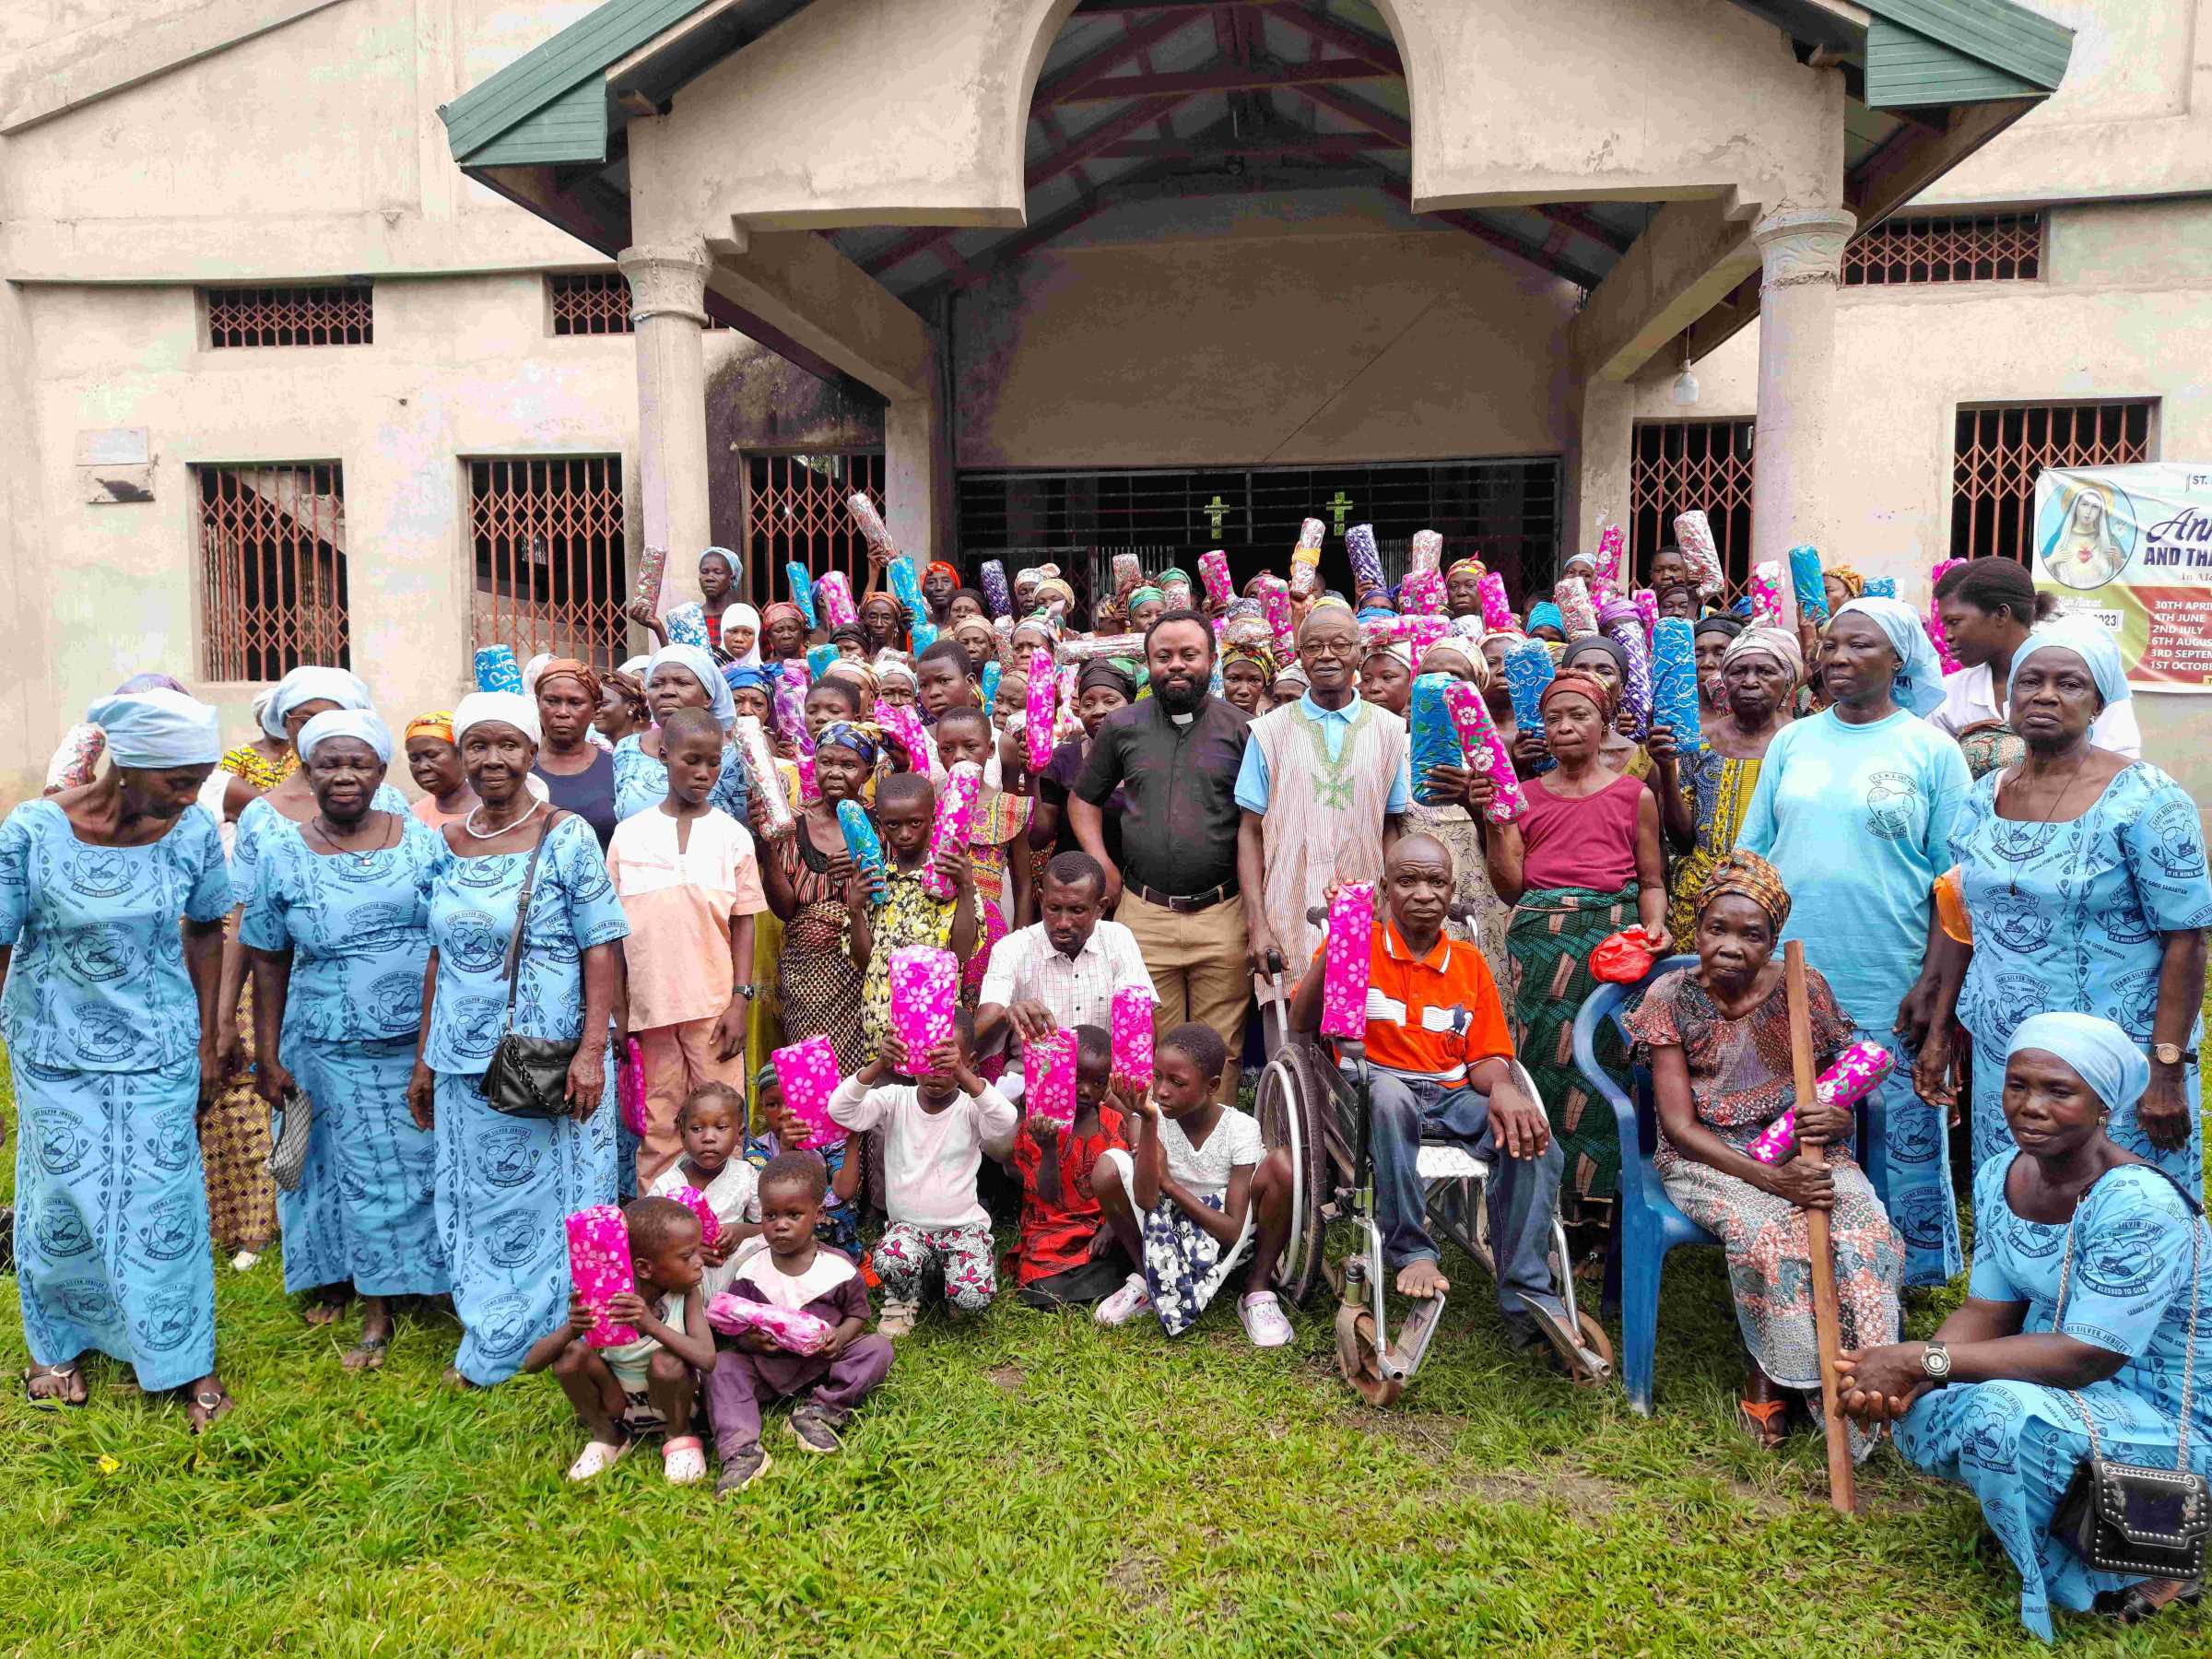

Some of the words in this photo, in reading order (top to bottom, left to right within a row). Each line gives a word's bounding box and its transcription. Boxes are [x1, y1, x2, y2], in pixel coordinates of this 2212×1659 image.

[2192, 475, 2208, 486] ST.
[2143, 547, 2181, 566] AND
[2186, 547, 2212, 567] TH
[2154, 600, 2183, 610] 30TH
[2153, 613, 2175, 622] 4TH
[2177, 613, 2206, 623] JUNE
[2152, 625, 2176, 634] 2ND
[2151, 637, 2173, 646] 6TH
[2150, 650, 2172, 658] 3RD
[2150, 661, 2170, 670] 1ST
[2077, 1325, 2101, 1337] SILVER
